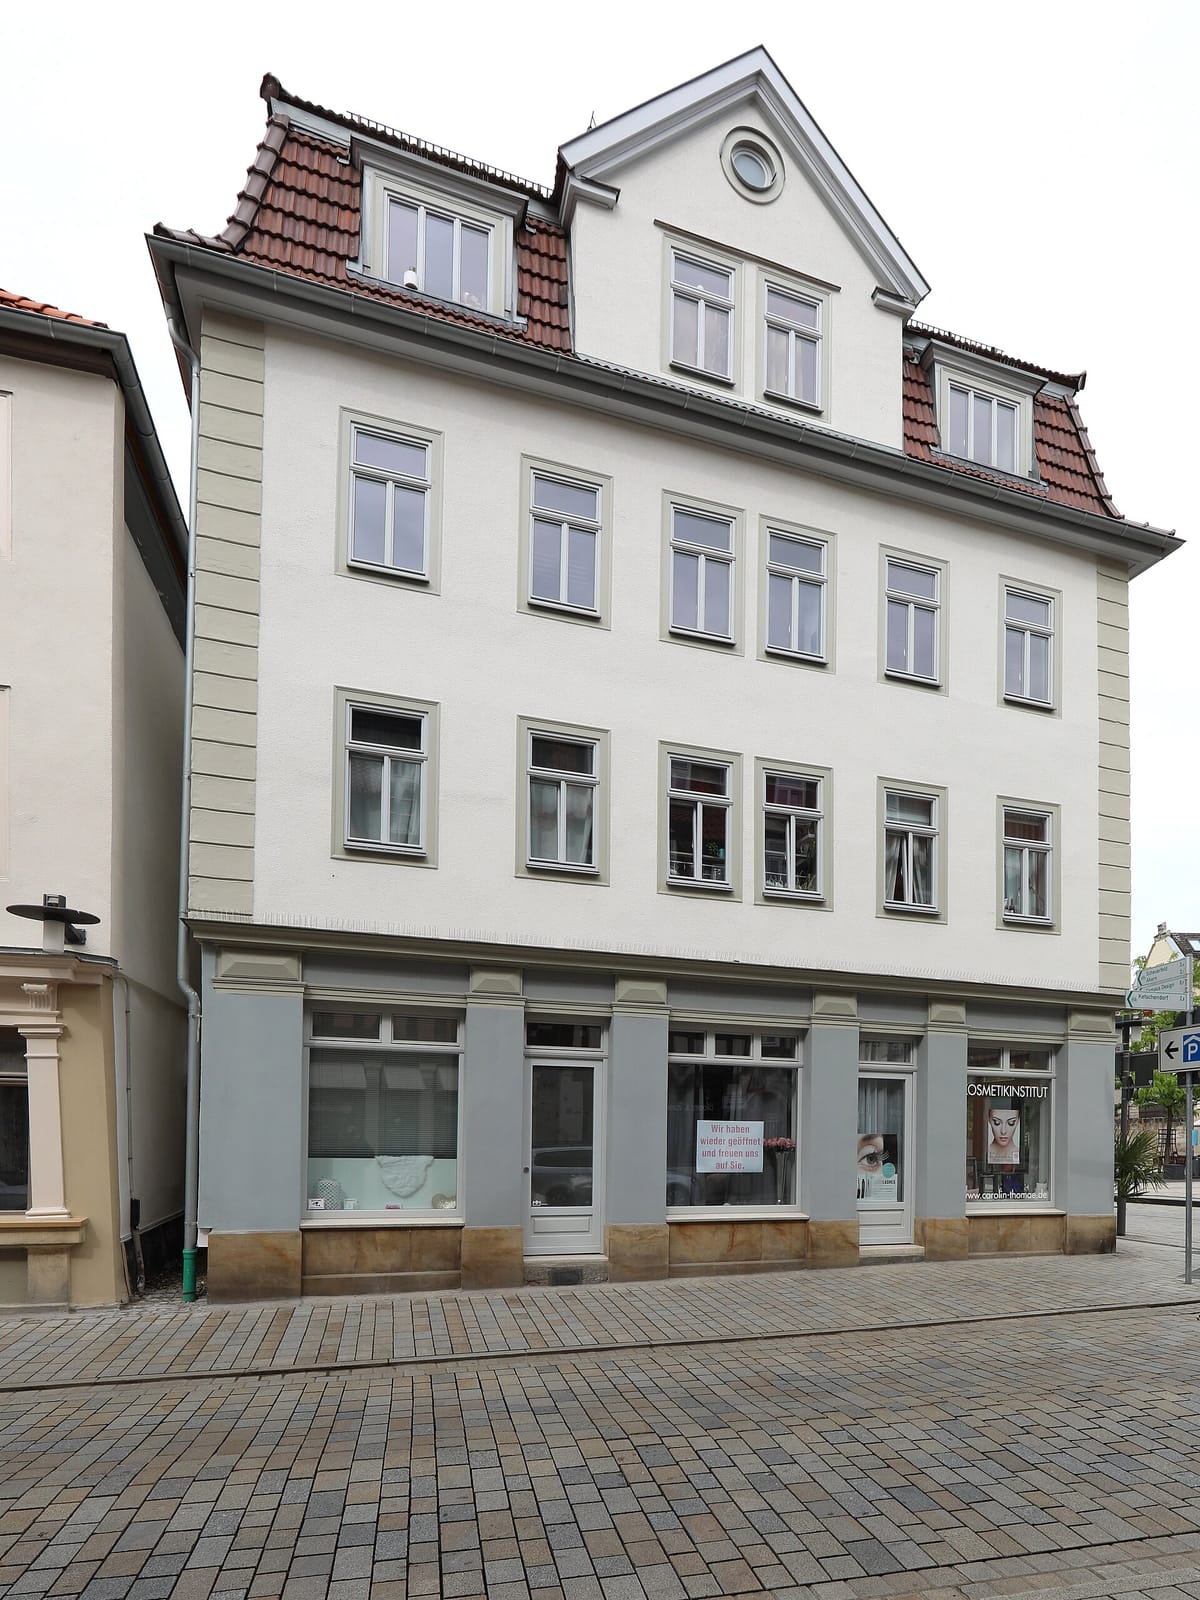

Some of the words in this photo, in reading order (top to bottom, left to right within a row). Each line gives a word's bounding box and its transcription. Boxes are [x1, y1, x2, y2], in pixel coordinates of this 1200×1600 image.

[1188, 1043, 1198, 1061] P
[966, 1084, 1048, 1098] OSMETIKINSTITUT
[711, 1124, 724, 1133] Wir
[726, 1124, 750, 1133] haben
[700, 1136, 726, 1145] wieder
[728, 1136, 761, 1147] geöffnet
[702, 1149, 716, 1157] und
[719, 1149, 743, 1157] freuen
[715, 1161, 728, 1169] auf
[729, 1161, 745, 1169] Sie.
[966, 1189, 1047, 1200] ww.carolin-thomae.de
